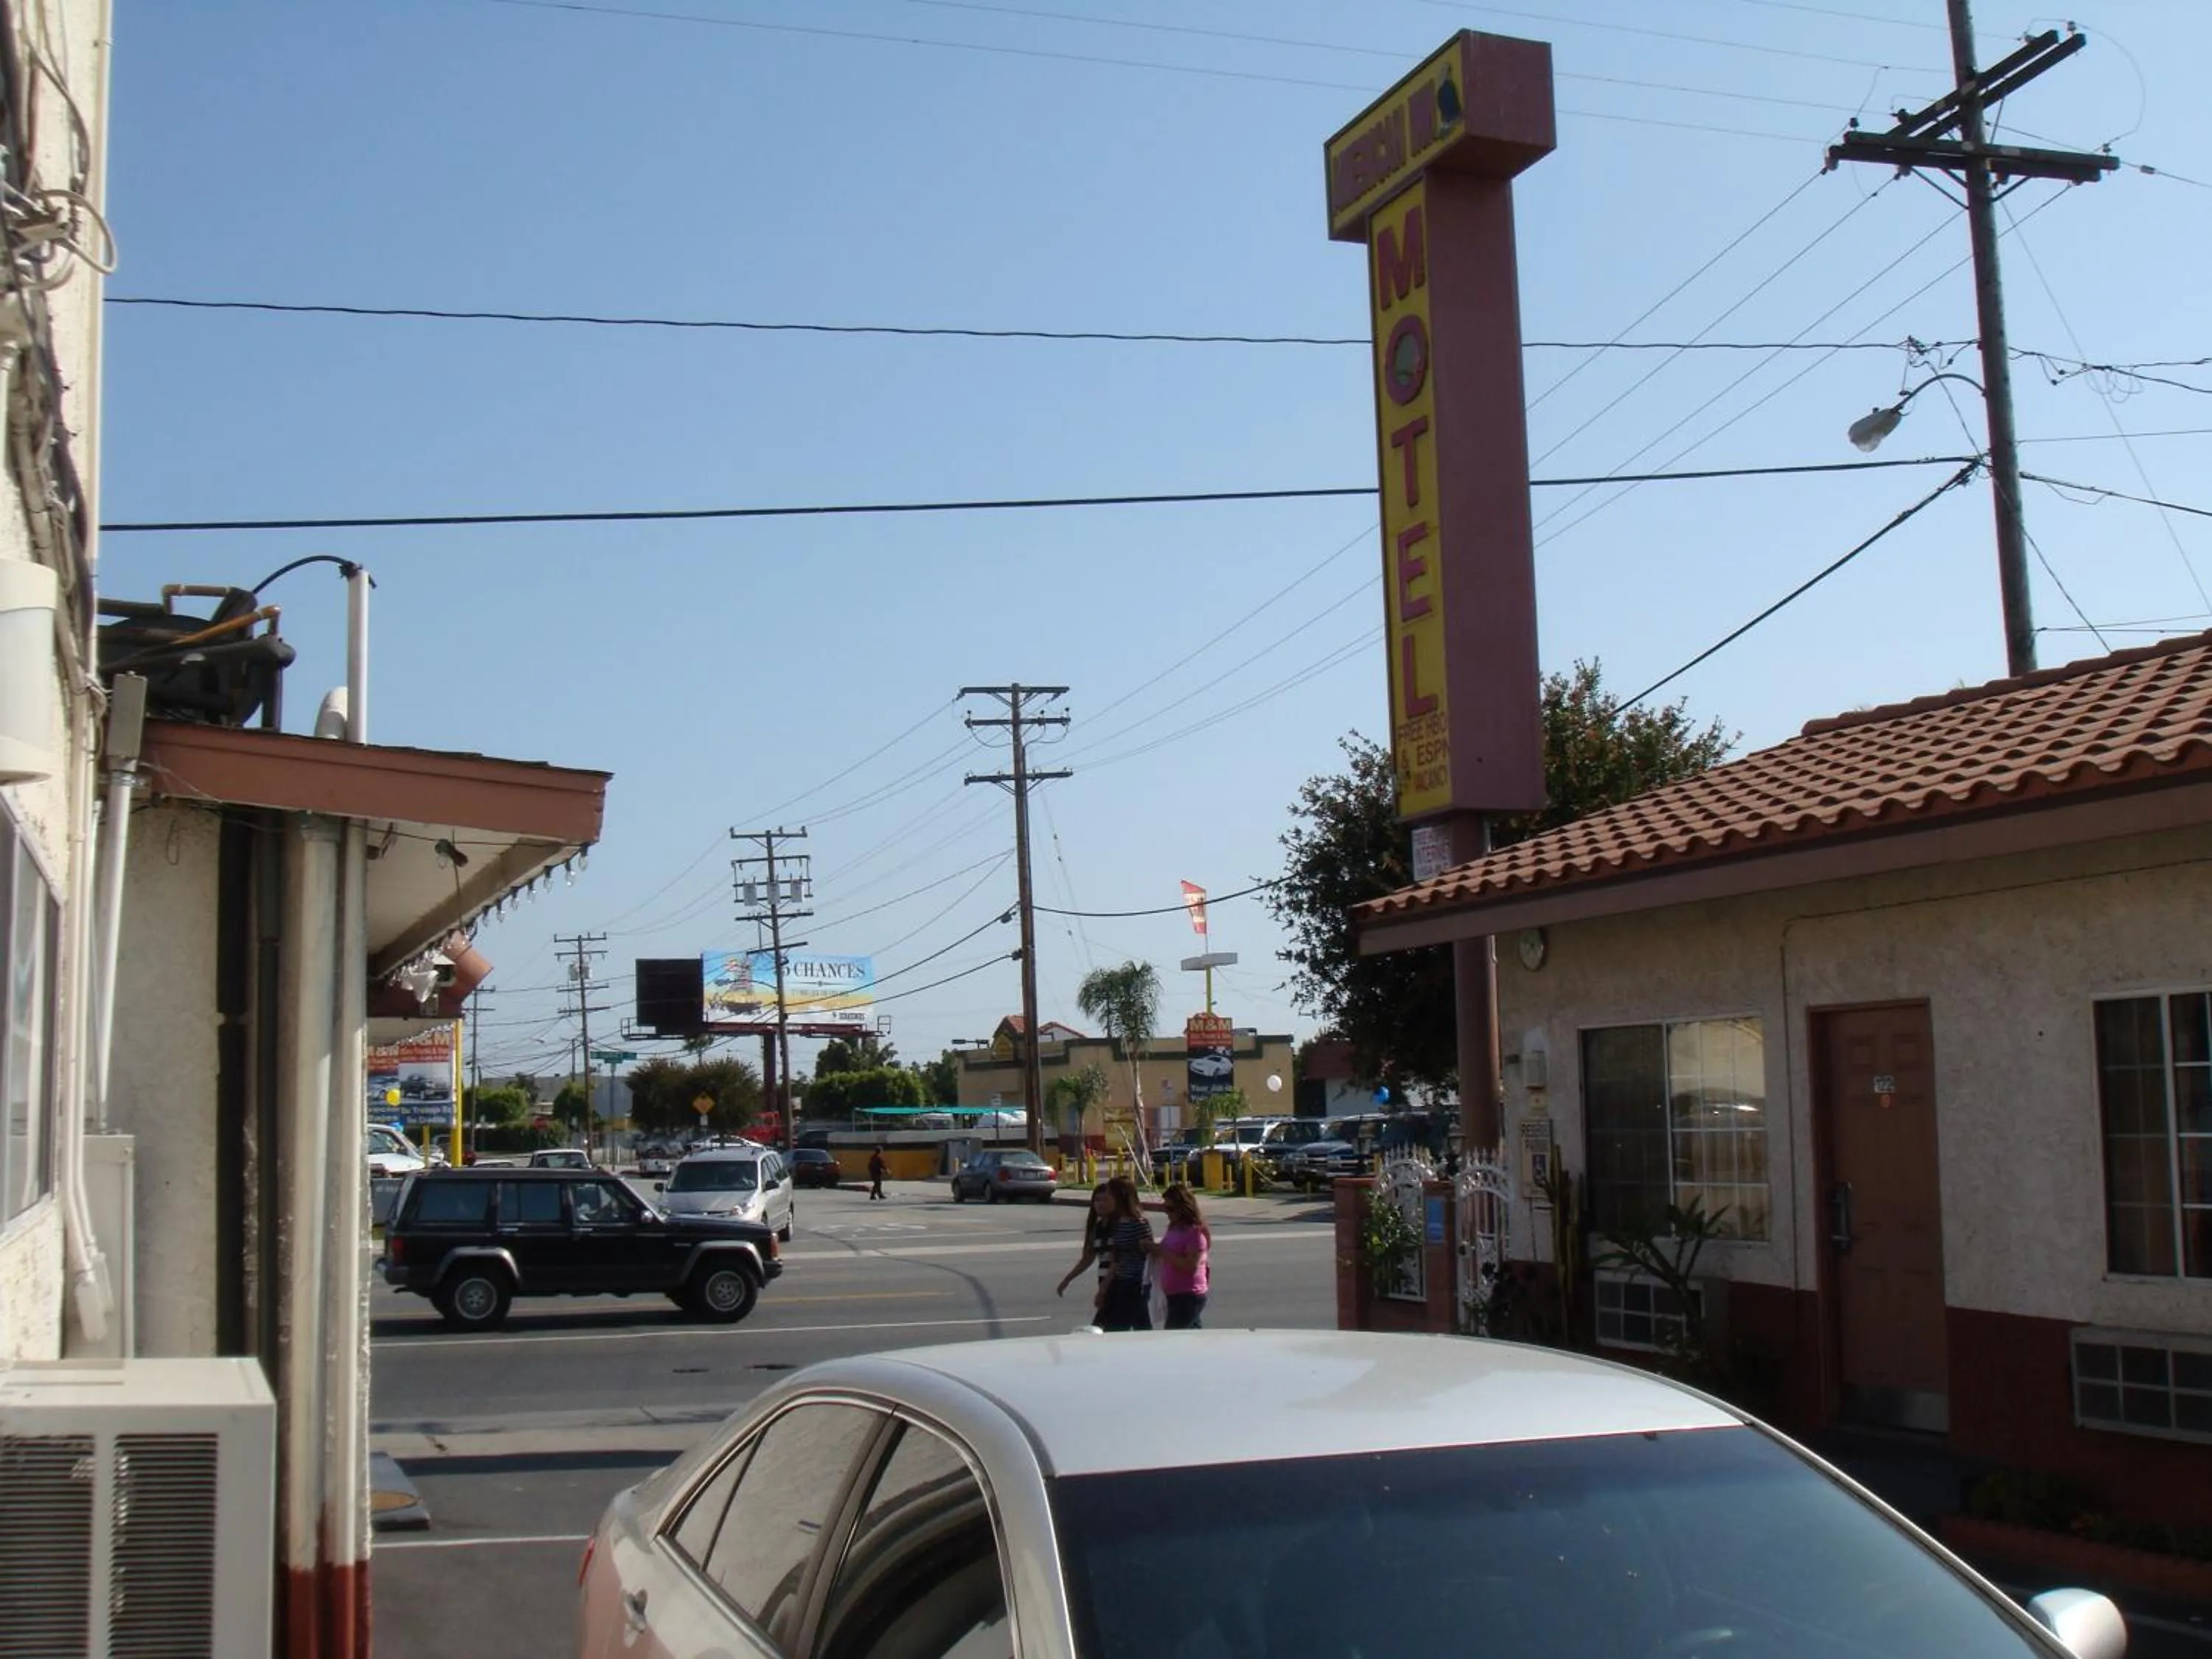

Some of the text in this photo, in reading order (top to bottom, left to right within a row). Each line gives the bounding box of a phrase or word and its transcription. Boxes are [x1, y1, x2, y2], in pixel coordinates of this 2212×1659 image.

[1377, 204, 1440, 719] MOTEL
[793, 961, 866, 979] CHANCES
[1189, 1018, 1231, 1031] M&M
